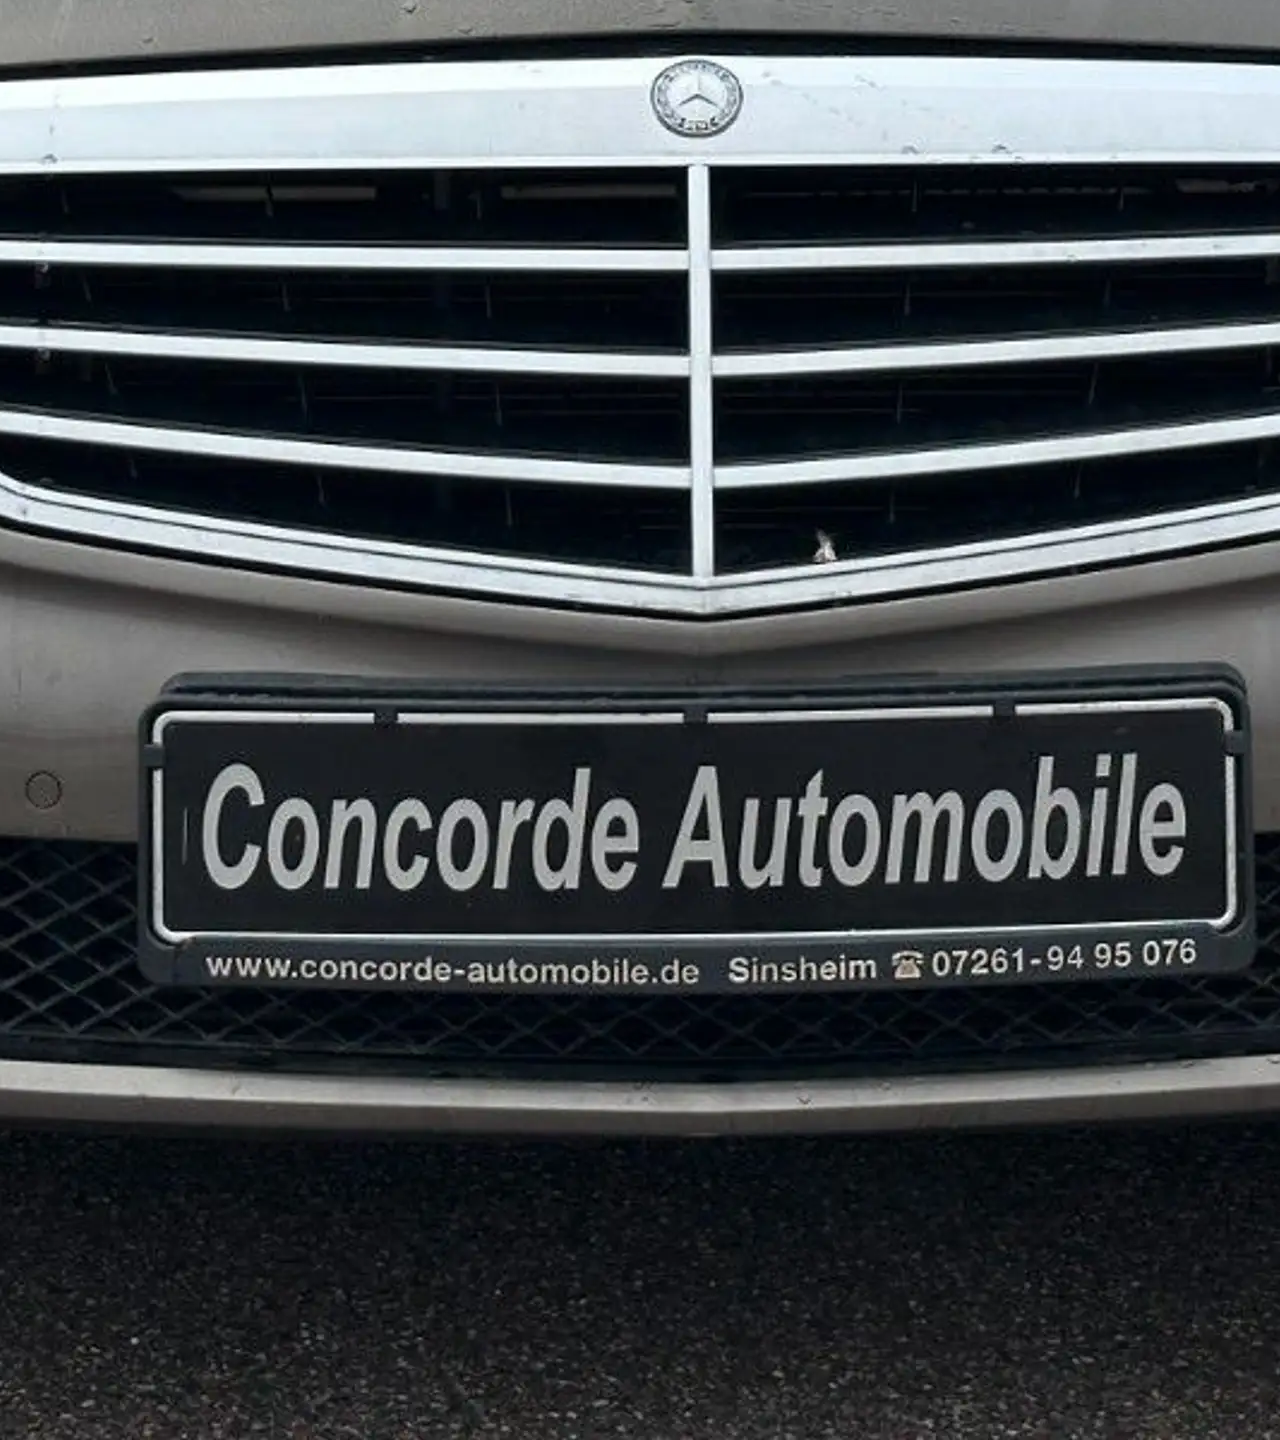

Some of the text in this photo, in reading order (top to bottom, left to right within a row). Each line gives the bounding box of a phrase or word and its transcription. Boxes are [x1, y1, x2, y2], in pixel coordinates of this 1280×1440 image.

[202, 753, 1187, 892] Concorde Automobile
[206, 938, 1197, 985] www.concorde-automobile.de Sinsheim 07261-94 95 076
